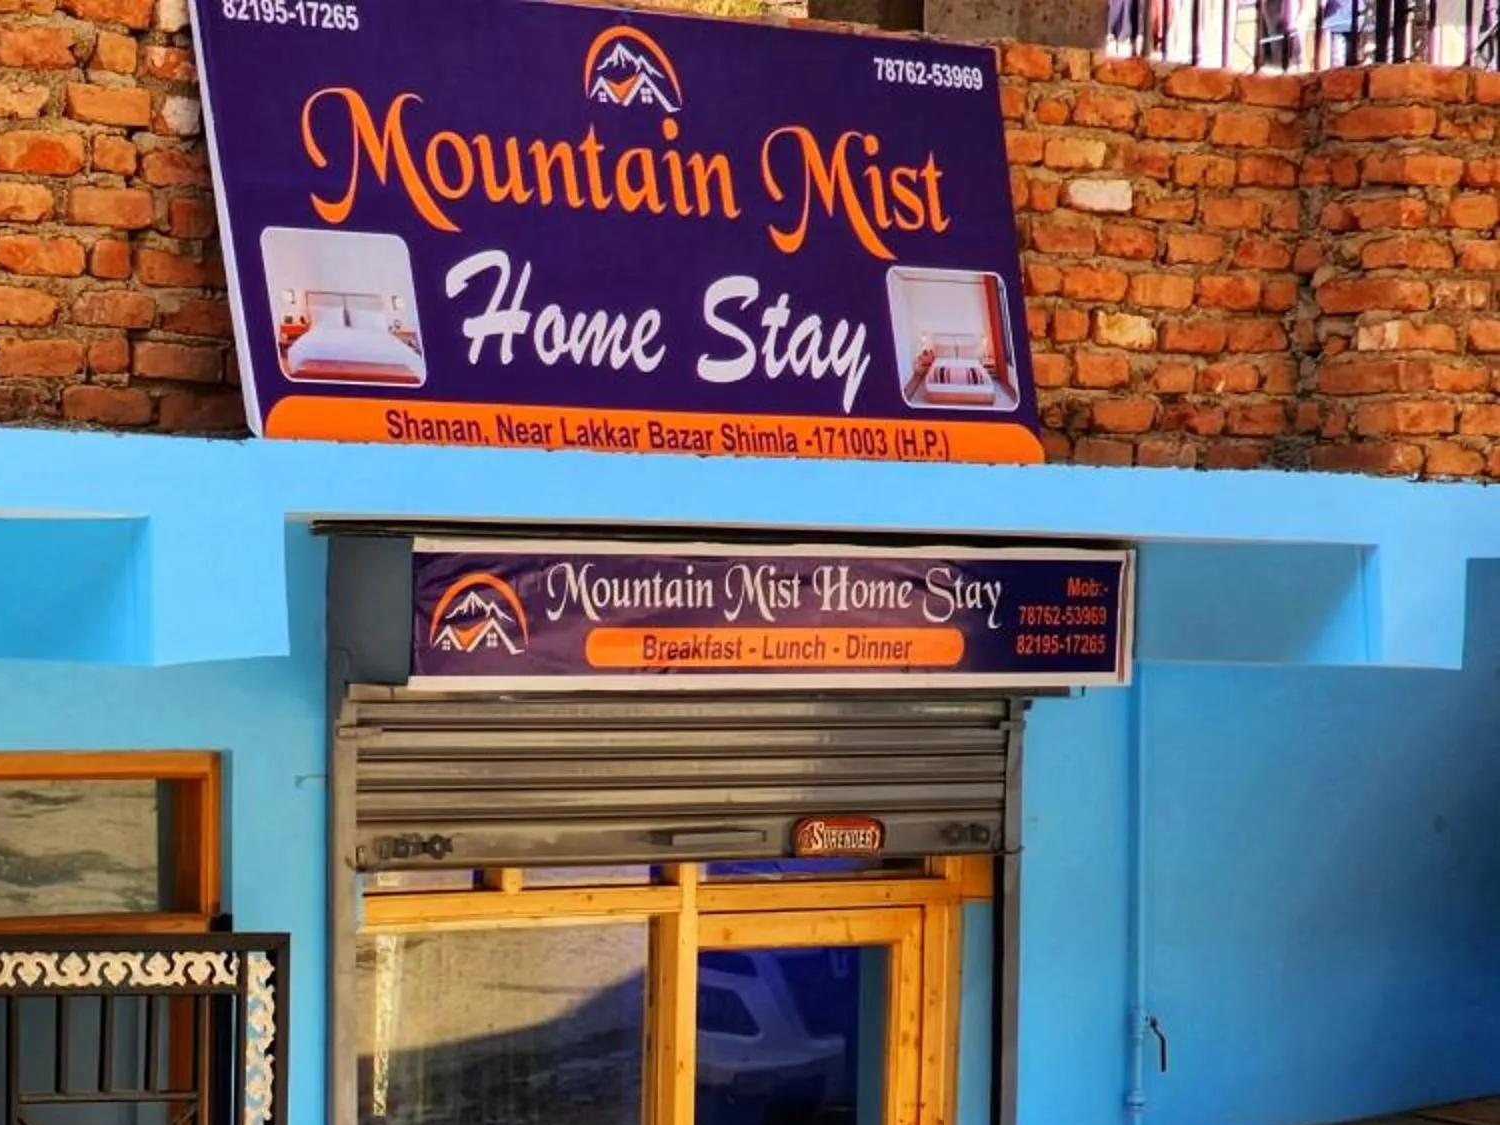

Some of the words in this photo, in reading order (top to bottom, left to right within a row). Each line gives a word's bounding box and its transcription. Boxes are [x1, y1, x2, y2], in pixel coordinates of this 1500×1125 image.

[222, 0, 360, 31] 82195-17265
[873, 56, 984, 91] 78762-53969
[302, 86, 741, 233] Mountain
[761, 126, 951, 261] Mist
[445, 249, 666, 373] Home
[696, 275, 872, 414] Stay
[385, 409, 489, 444] Shanan,
[495, 413, 553, 445] Near
[560, 417, 641, 449] Lakkar
[647, 420, 714, 450] Bazar
[720, 423, 798, 453] Shimla
[894, 429, 950, 460] (H.P.)
[546, 562, 714, 622] Mountain
[723, 564, 801, 623] Mist
[812, 565, 914, 612] Home
[922, 566, 1002, 629] Stay
[1017, 605, 1107, 626] 78762-53969
[642, 634, 743, 662] Breakfast
[762, 635, 827, 661] Lunch
[845, 634, 913, 661] Dinner
[1015, 634, 1106, 654] 82195-17265
